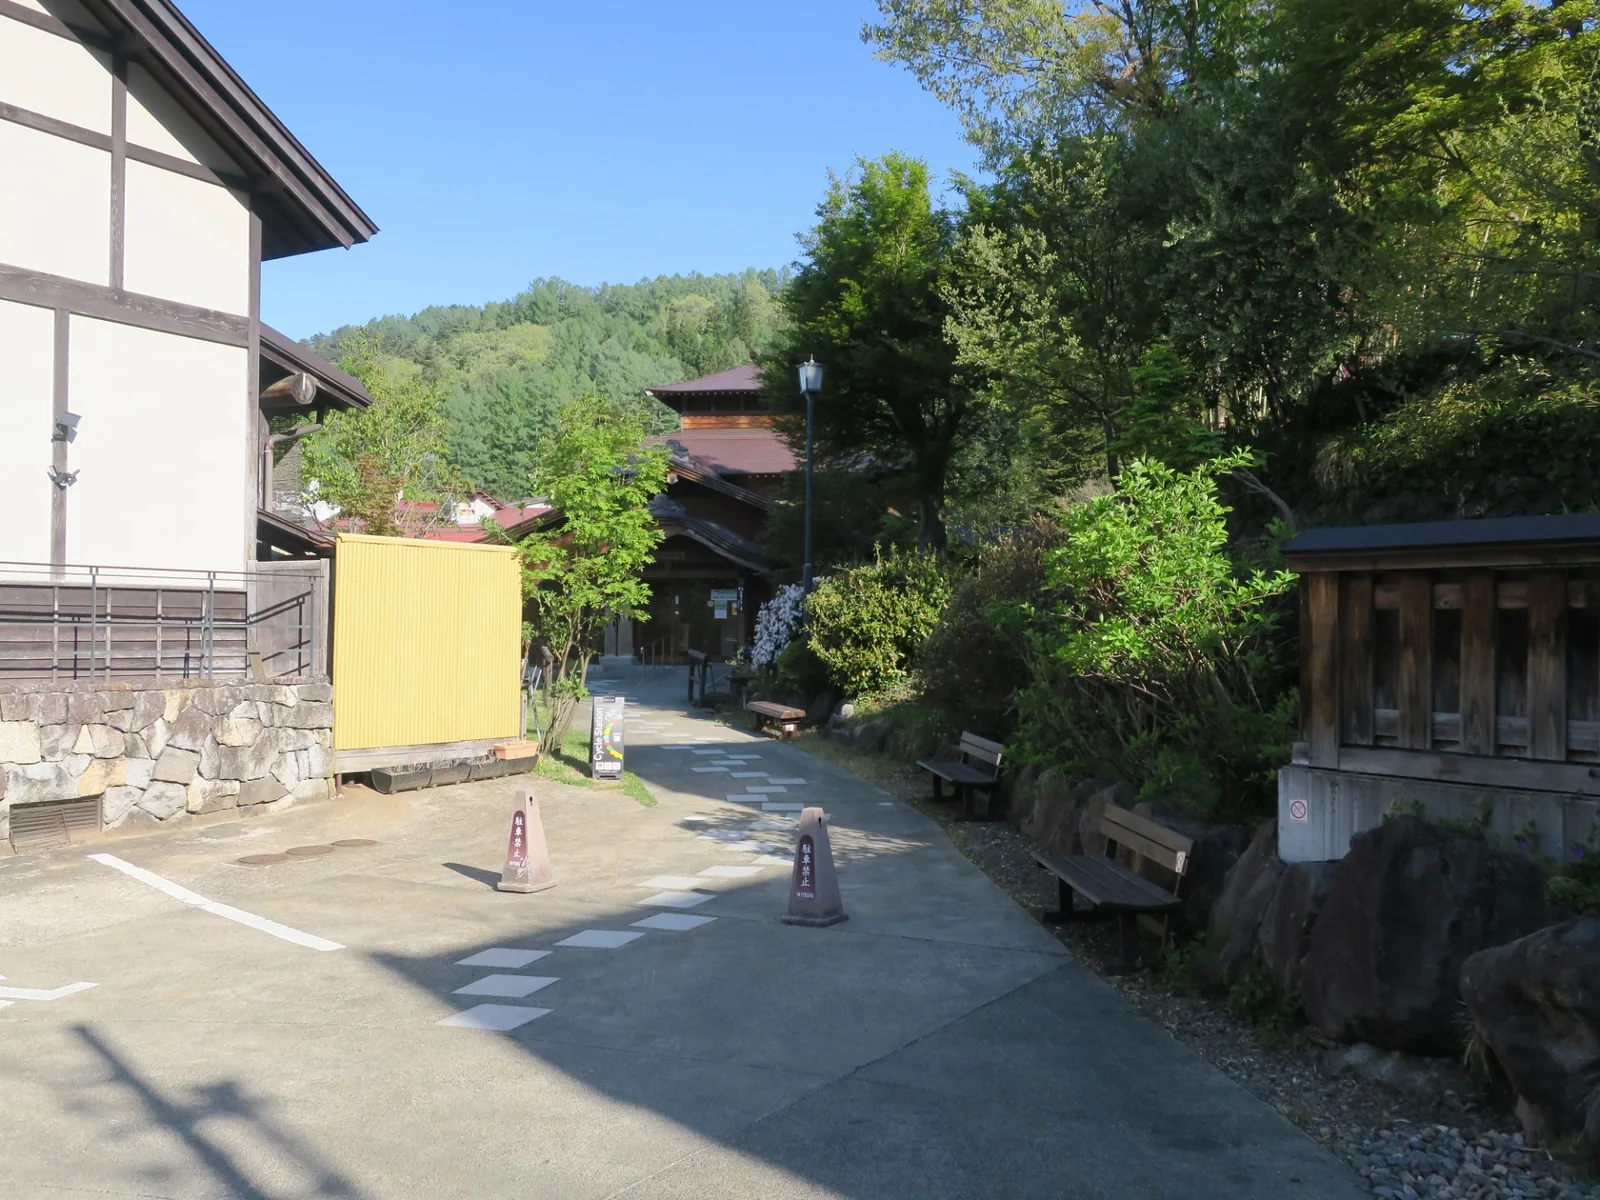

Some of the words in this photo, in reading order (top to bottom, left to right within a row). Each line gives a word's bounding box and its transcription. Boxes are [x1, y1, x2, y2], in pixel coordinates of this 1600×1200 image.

[594, 707, 603, 736] Station
[594, 737, 604, 760] Cycle
[513, 816, 524, 858] 駐車禁止
[801, 844, 811, 887] 駐車禁止
